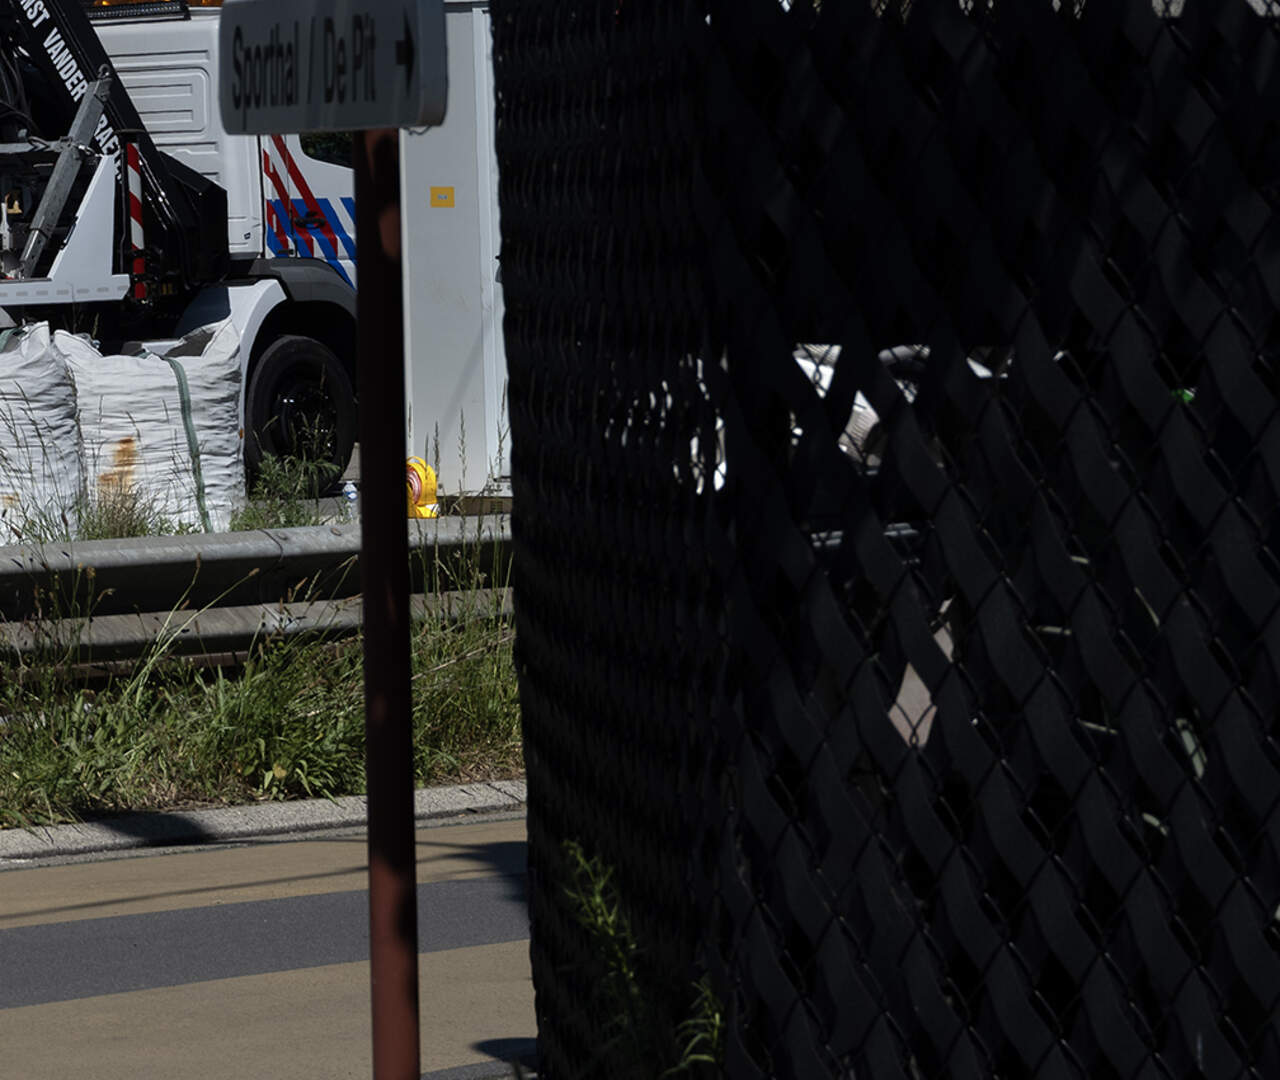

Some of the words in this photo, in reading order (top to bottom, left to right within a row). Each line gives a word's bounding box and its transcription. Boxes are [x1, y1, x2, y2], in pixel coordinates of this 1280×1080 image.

[43, 27, 89, 102] VANDER
[232, 23, 299, 132] Sporthal
[324, 17, 346, 104] De
[352, 13, 376, 103] Pit
